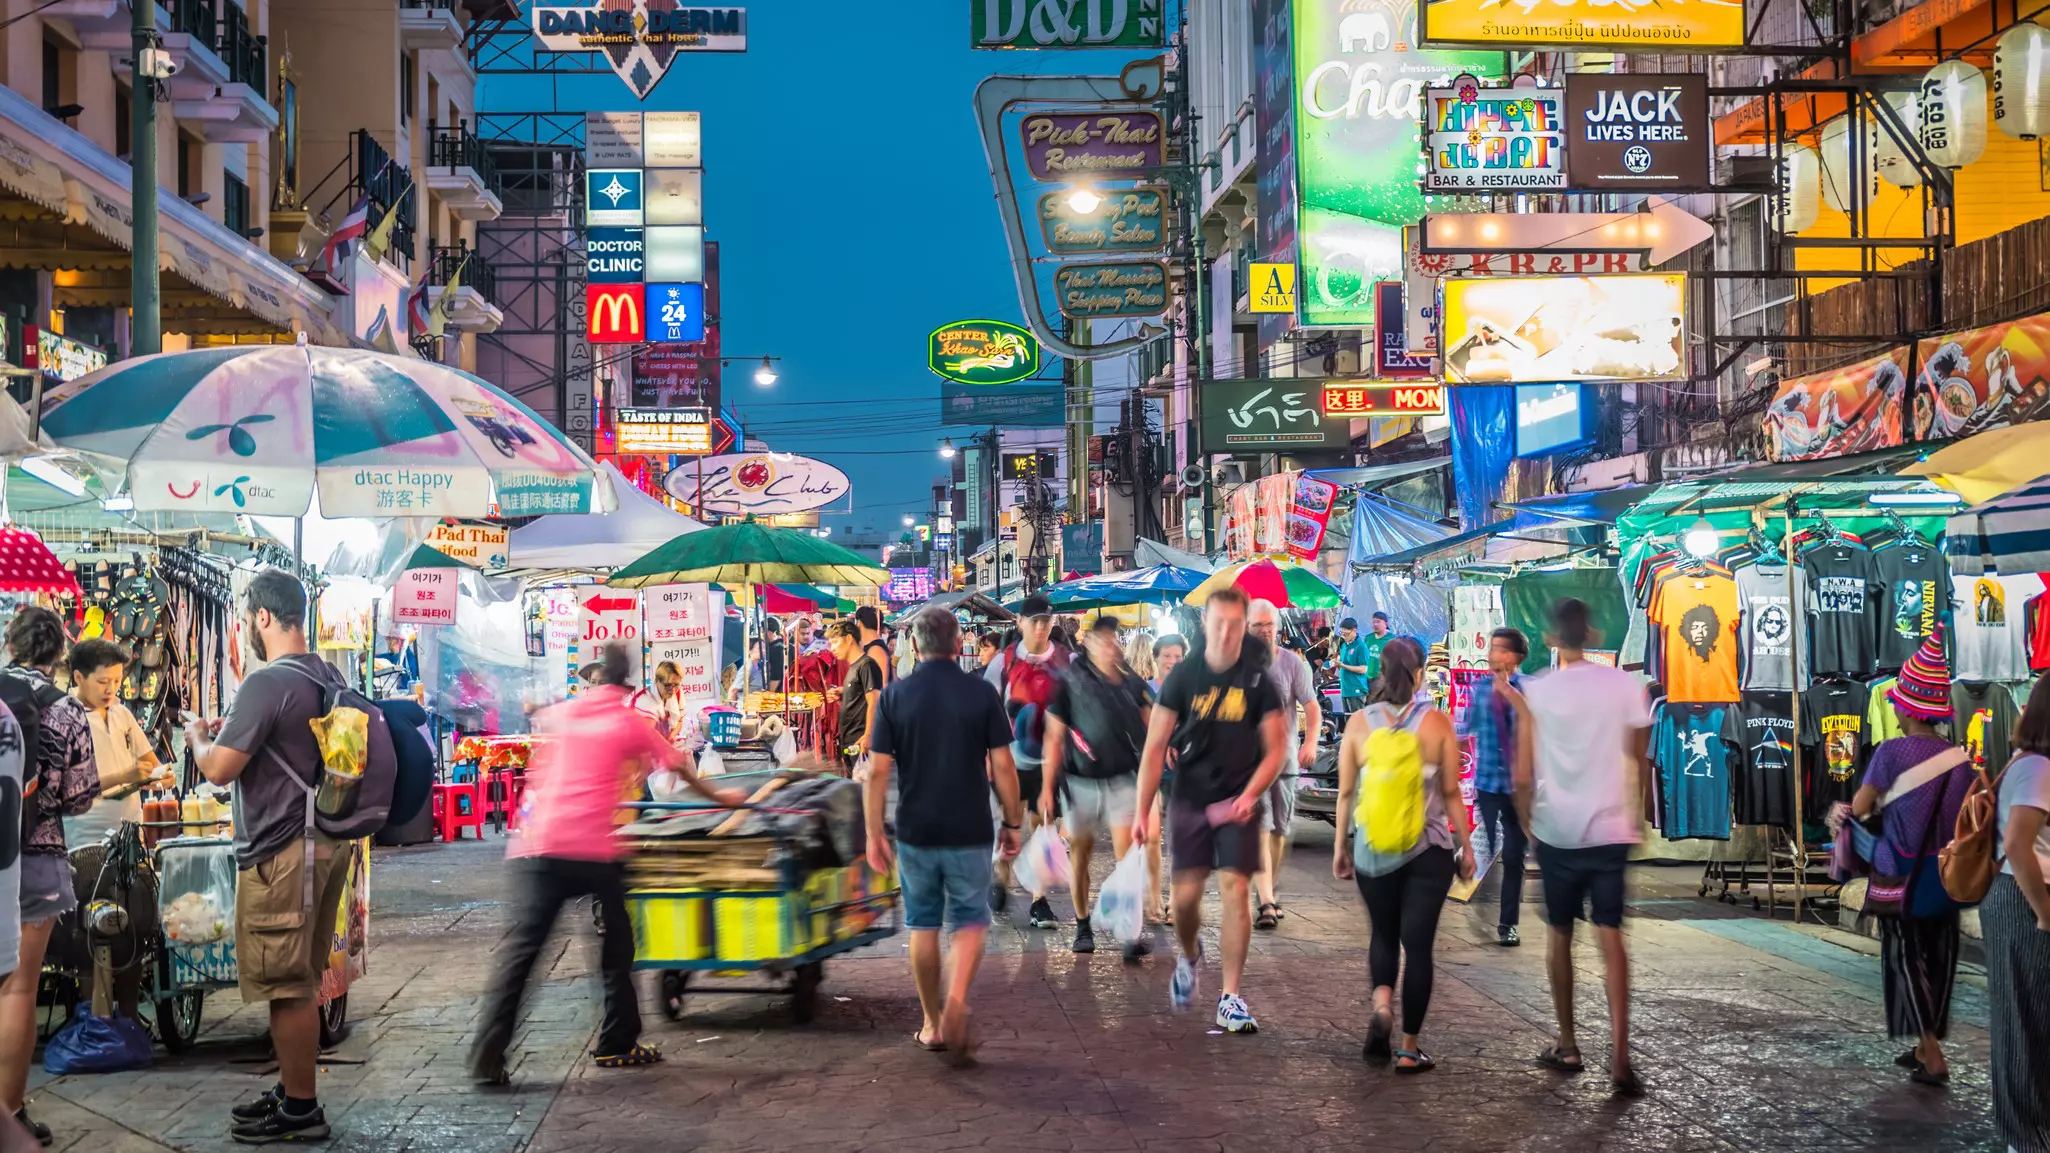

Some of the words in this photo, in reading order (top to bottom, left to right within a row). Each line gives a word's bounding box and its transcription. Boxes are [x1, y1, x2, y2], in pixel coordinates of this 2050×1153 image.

[539, 10, 631, 36] DANG
[649, 10, 740, 35] DERM
[579, 34, 633, 44] Authentic
[638, 33, 663, 43] Thai
[668, 32, 700, 43] Hotel
[1303, 61, 1421, 121] Cha
[1585, 90, 1683, 123] JACK
[1028, 117, 1158, 146] Pick-Thai
[1588, 125, 1634, 141] LIVES
[1640, 125, 1689, 141] HERE.
[1434, 174, 1461, 187] BAR
[1466, 174, 1476, 186] &
[1482, 174, 1563, 187] RESTAURANT
[1054, 223, 1107, 248] Beauty
[1110, 221, 1156, 244] Salon
[587, 240, 643, 252] DOCTOR
[587, 258, 643, 273] CLINIC
[1097, 269, 1163, 290] Massage
[1067, 291, 1123, 313] Shopping
[1124, 288, 1163, 307] Plaza
[1260, 295, 1295, 307] SILV
[661, 304, 687, 322] 24
[937, 330, 989, 343] CENTER
[938, 341, 980, 356] Khao
[1384, 348, 1431, 367] EXC
[635, 377, 678, 385] WHATEVER
[679, 377, 695, 385] YOU
[641, 388, 659, 396] JUST
[662, 388, 683, 396] HAVE
[686, 388, 707, 396] FU!
[572, 393, 589, 452] FOO
[622, 412, 657, 423] TASTE
[657, 412, 673, 423] OF
[673, 412, 705, 423] INDIA
[355, 469, 393, 486] dtac
[398, 469, 453, 492] Happy
[685, 466, 739, 502] The
[764, 475, 839, 497] Club
[248, 484, 276, 499] dtac
[376, 489, 434, 509] 游客卡
[436, 527, 465, 542] Pad
[469, 528, 506, 544] Thai
[440, 546, 478, 558] aifood
[412, 573, 442, 583] 여기가
[416, 590, 436, 600] 원조
[663, 592, 692, 602] 여기가
[1769, 596, 1790, 604] DUD
[399, 607, 420, 617] 조조
[421, 608, 451, 619] 파타이
[669, 610, 688, 620] 원조
[1920, 580, 1936, 637] NIRVANA
[655, 629, 674, 639] 조조
[677, 626, 706, 637] 파타이
[664, 648, 700, 659] 여기가!!
[684, 665, 704, 676] 지널
[1746, 717, 1767, 728] PINK
[1768, 717, 1795, 729] FLOYD
